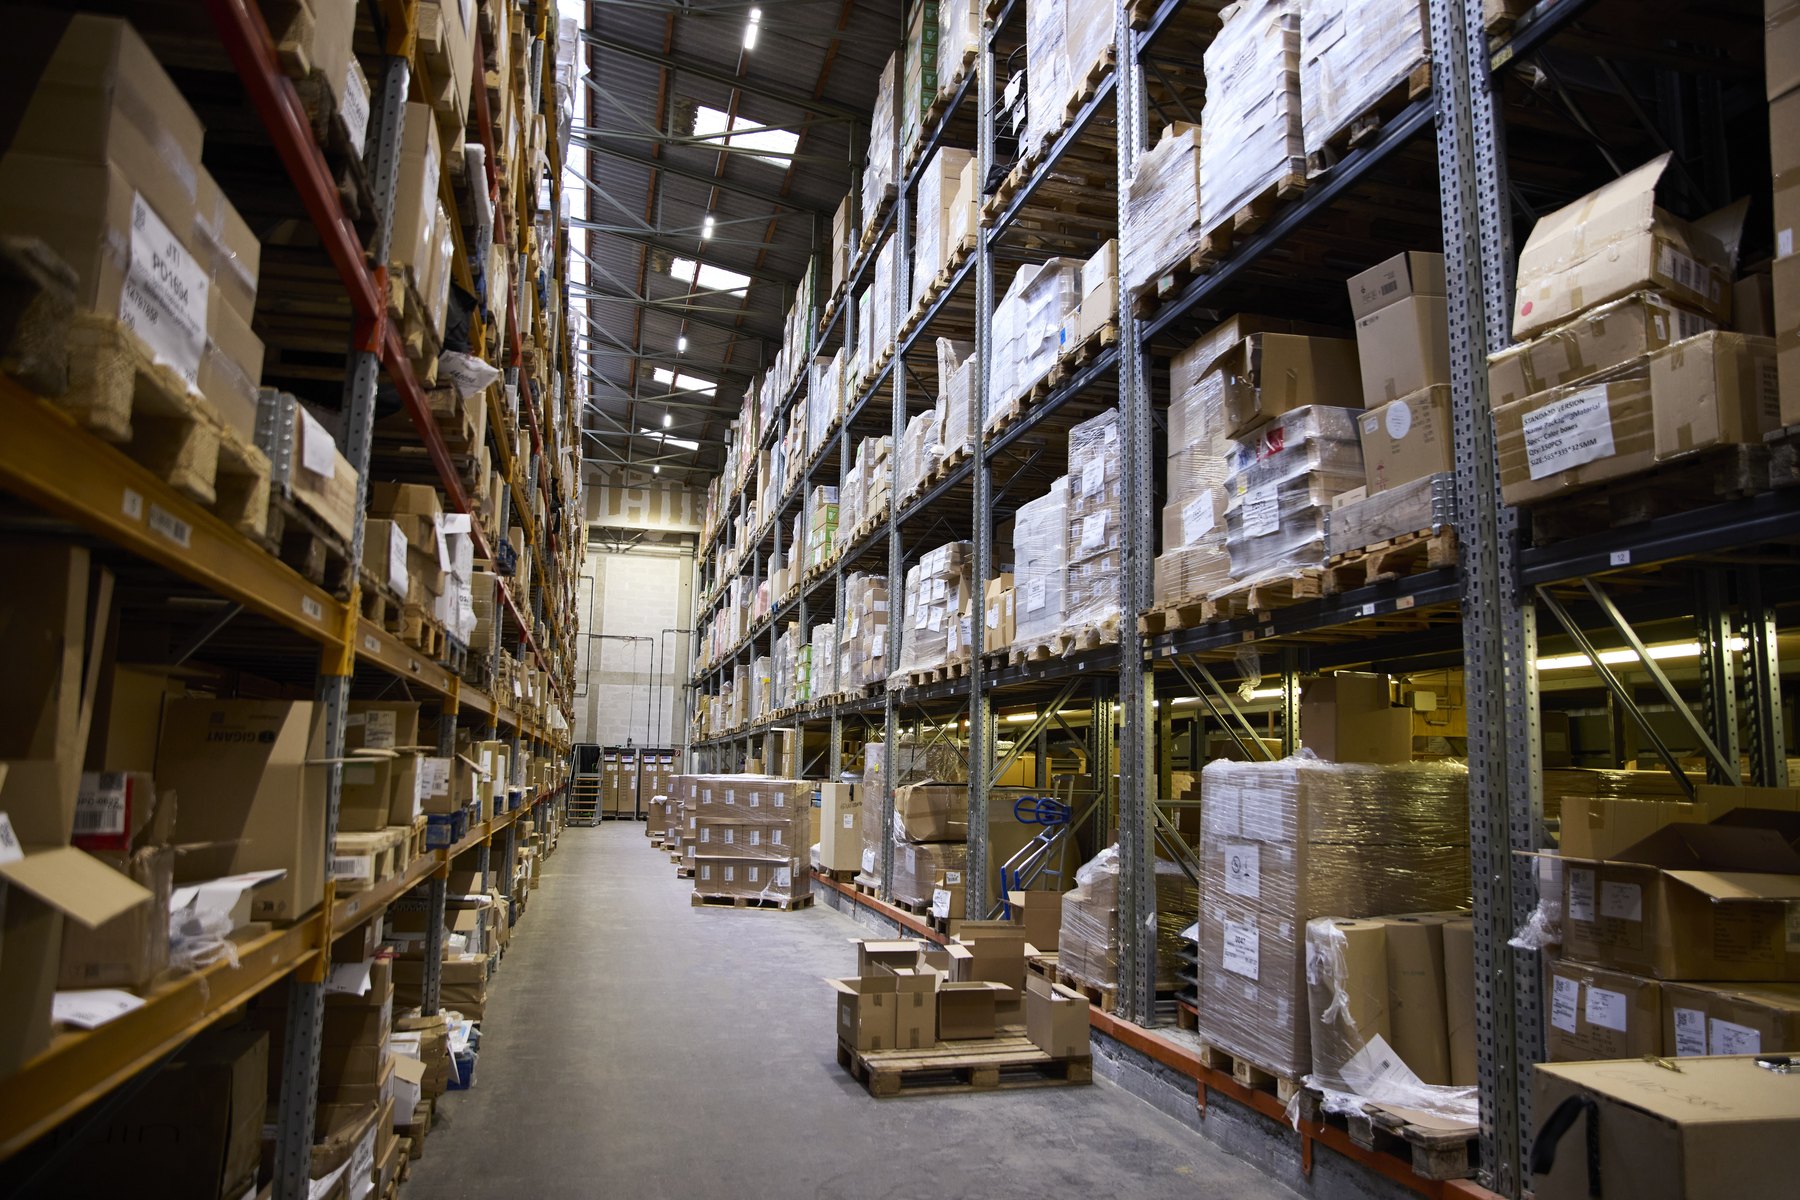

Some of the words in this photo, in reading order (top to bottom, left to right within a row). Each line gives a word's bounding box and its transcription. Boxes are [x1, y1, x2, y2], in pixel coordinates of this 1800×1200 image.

[1523, 407, 1556, 425] STANDARD
[1557, 397, 1585, 413] VERSION
[1559, 424, 1578, 435] boxes
[206, 730, 256, 743] GIGANT
